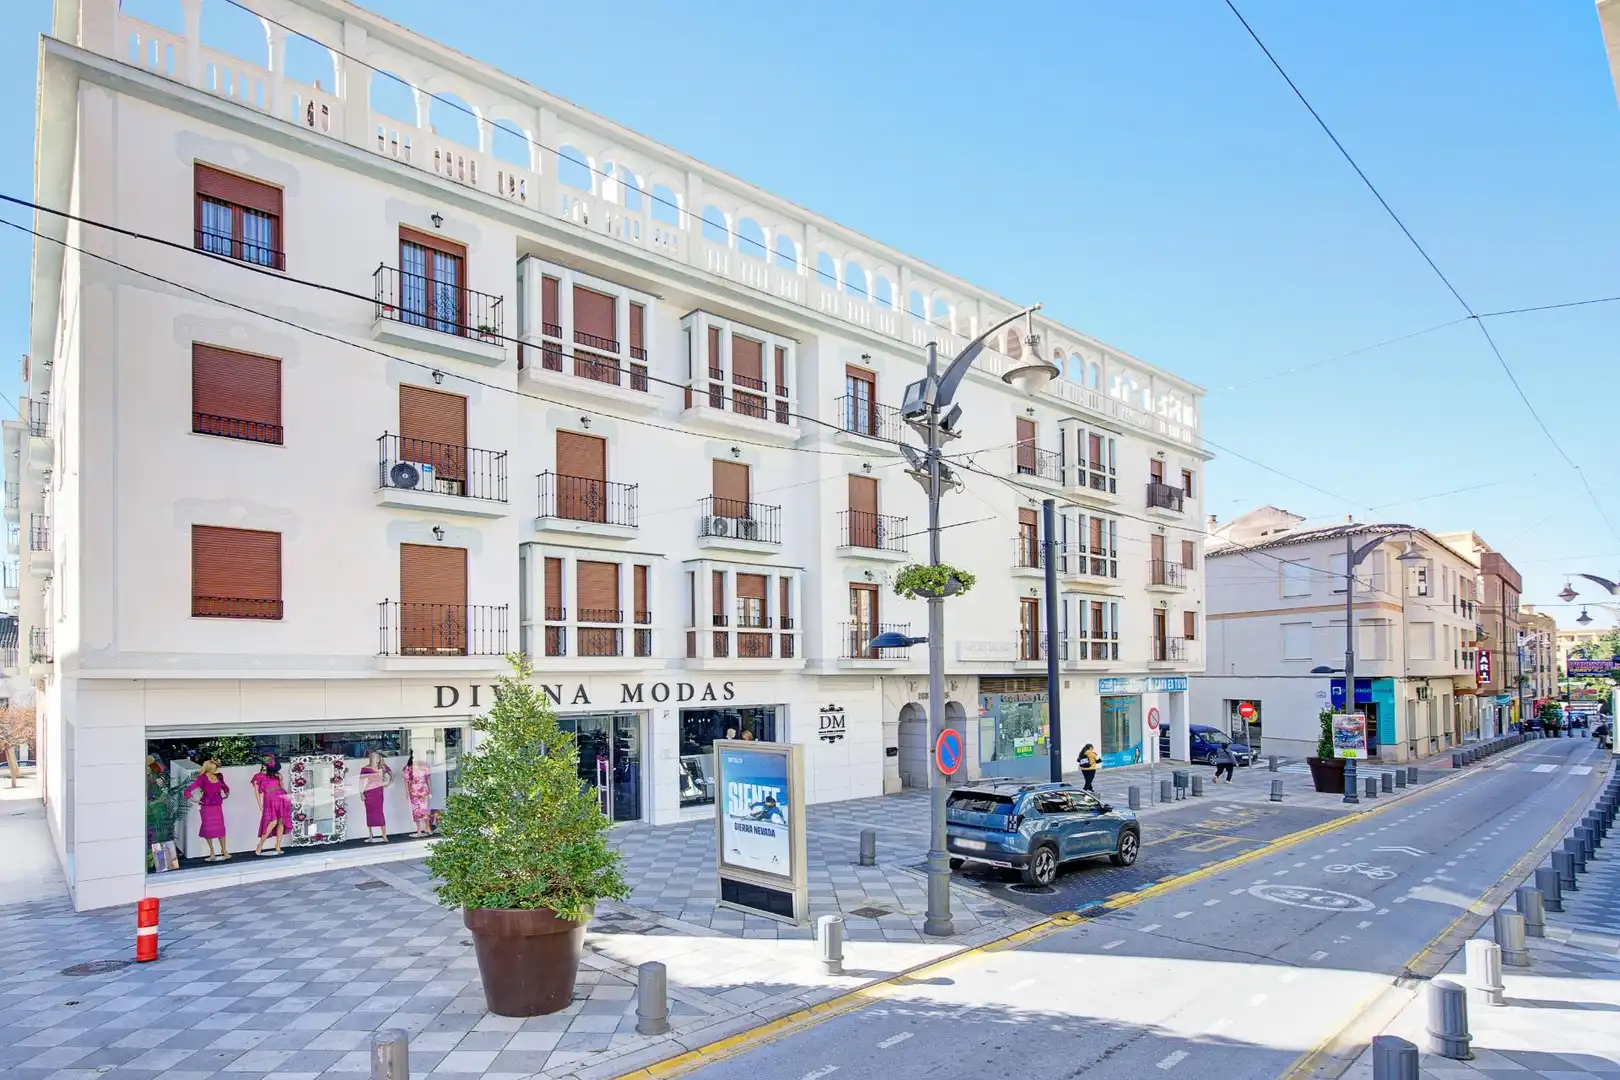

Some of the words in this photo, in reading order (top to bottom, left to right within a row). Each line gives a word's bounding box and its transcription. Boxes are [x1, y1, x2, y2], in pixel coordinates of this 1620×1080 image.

[434, 683, 591, 708] DINA
[620, 681, 735, 703] MODAS
[820, 715, 845, 729] DM
[734, 822, 753, 834] SIERRA
[753, 826, 776, 838] NEVADA
